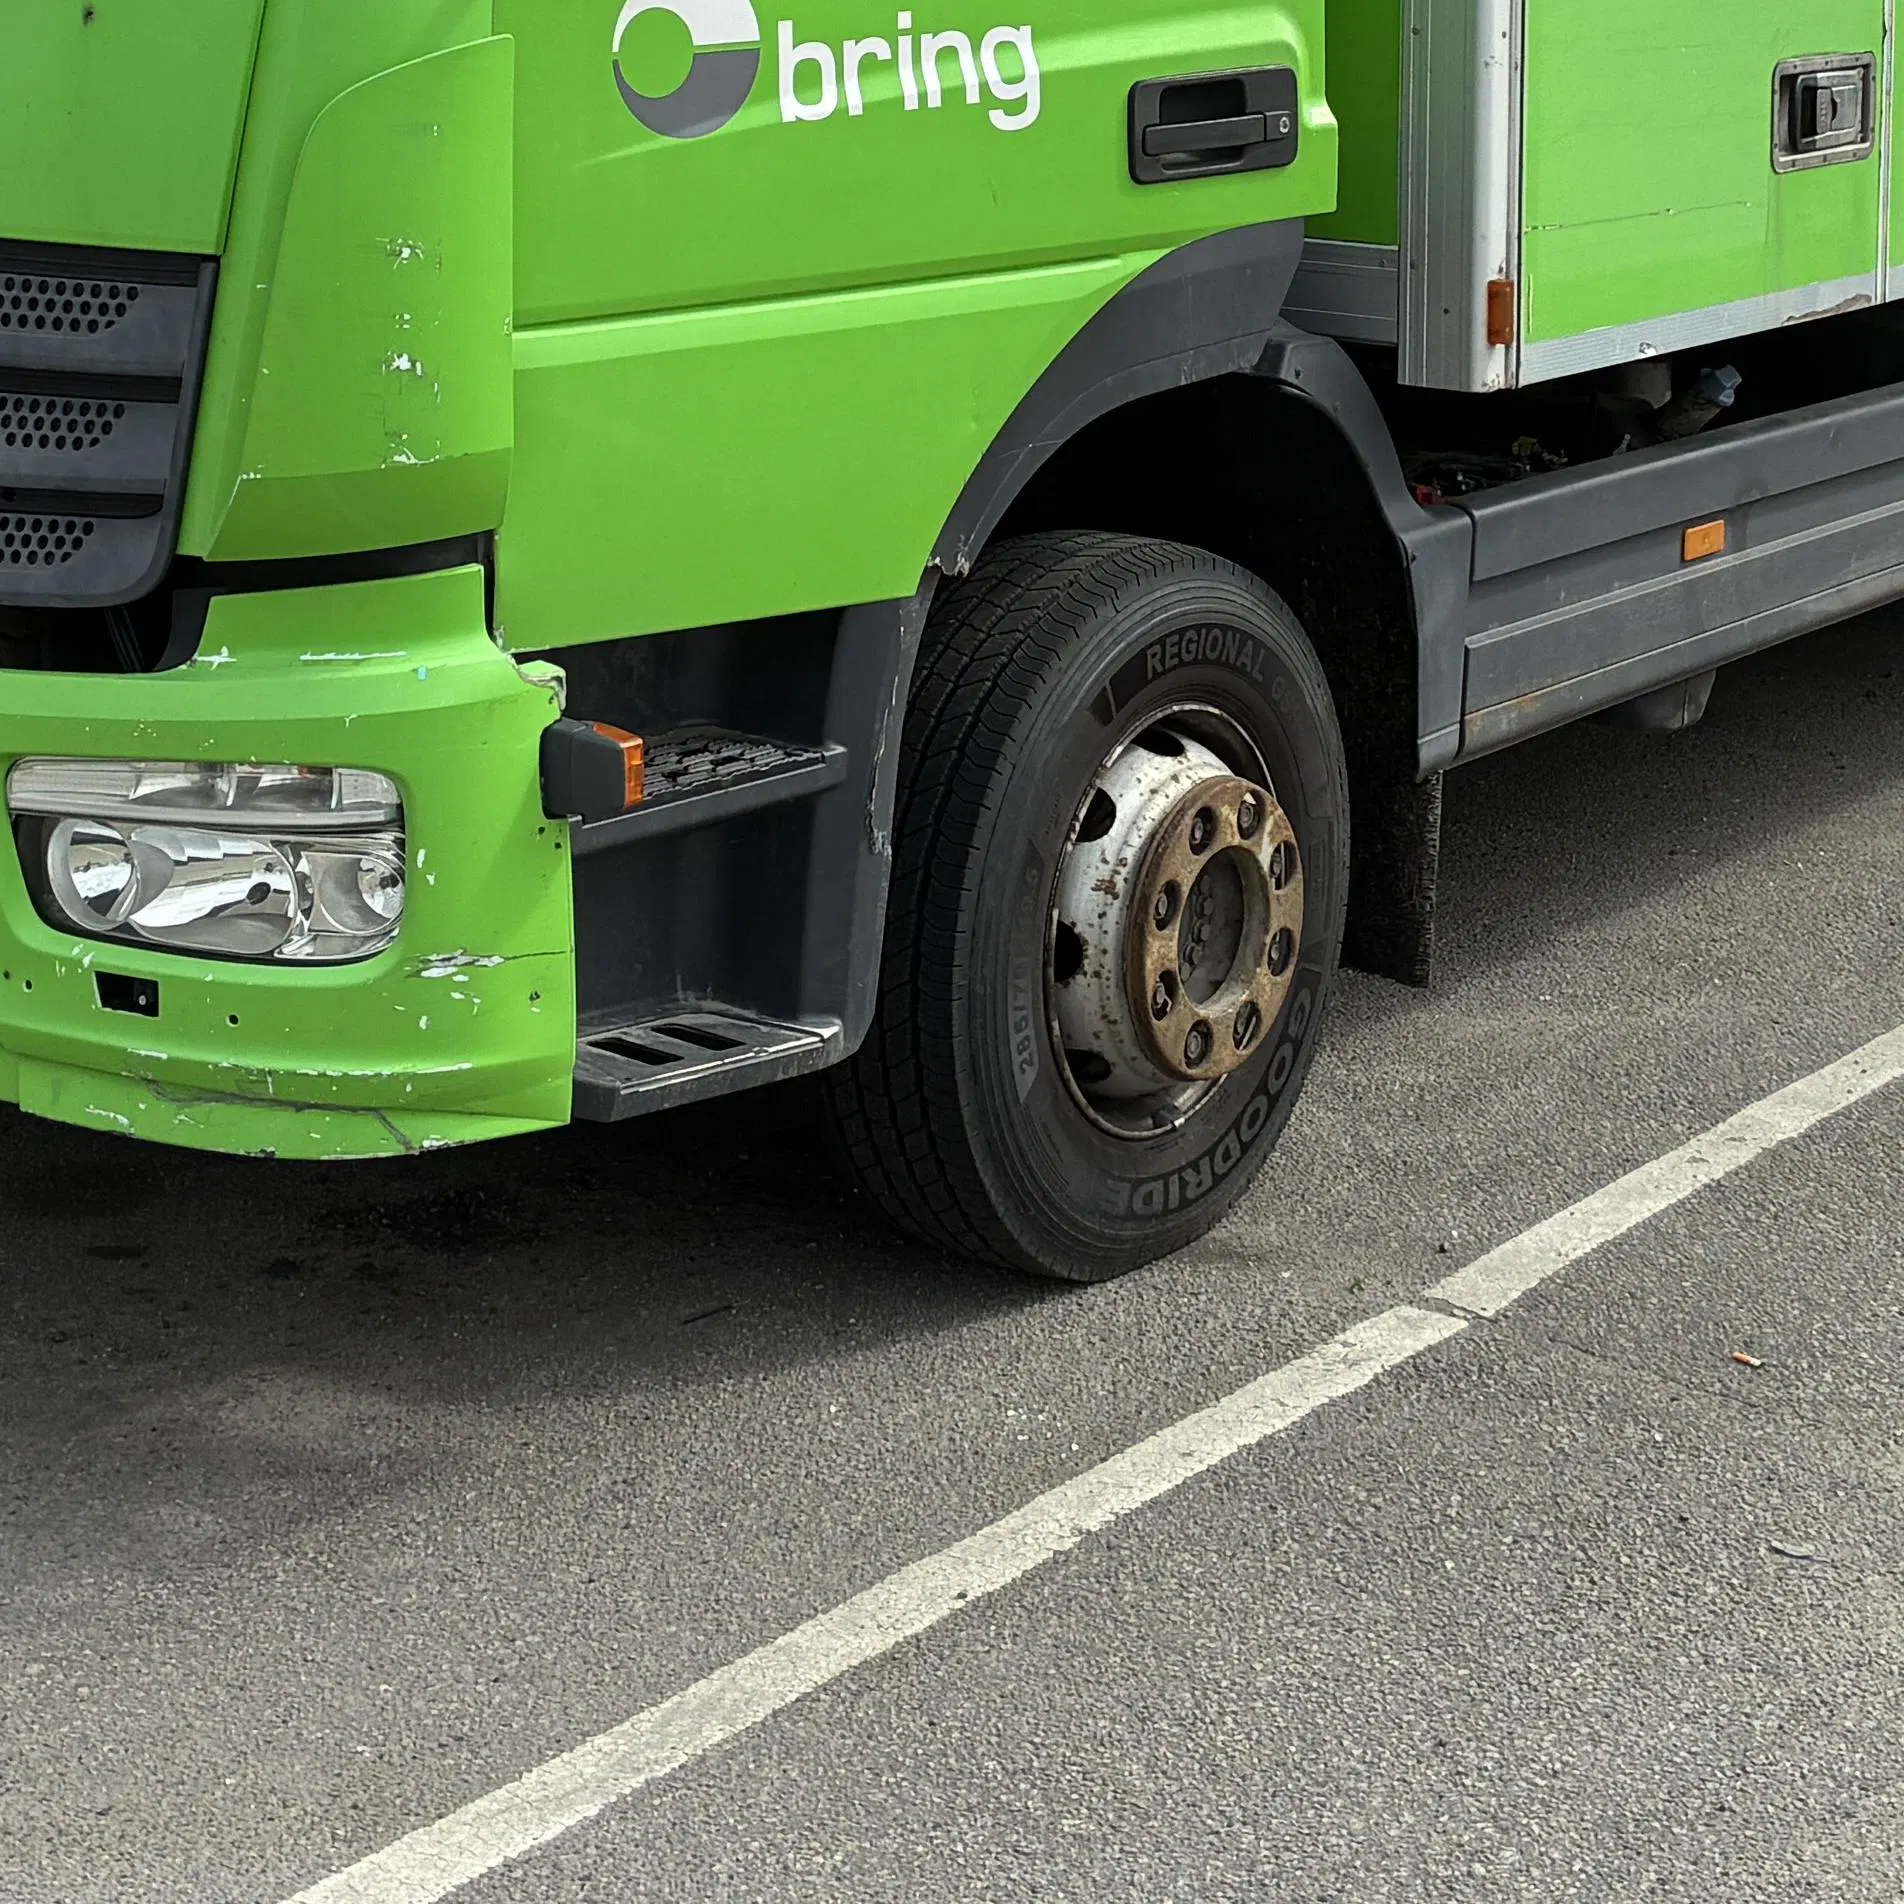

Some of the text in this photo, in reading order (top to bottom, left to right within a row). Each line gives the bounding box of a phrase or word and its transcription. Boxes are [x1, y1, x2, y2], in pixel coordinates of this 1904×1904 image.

[777, 10, 1042, 131] bring
[1146, 627, 1268, 684] REGIONAL
[1099, 987, 1313, 1217] GOODRIDE
